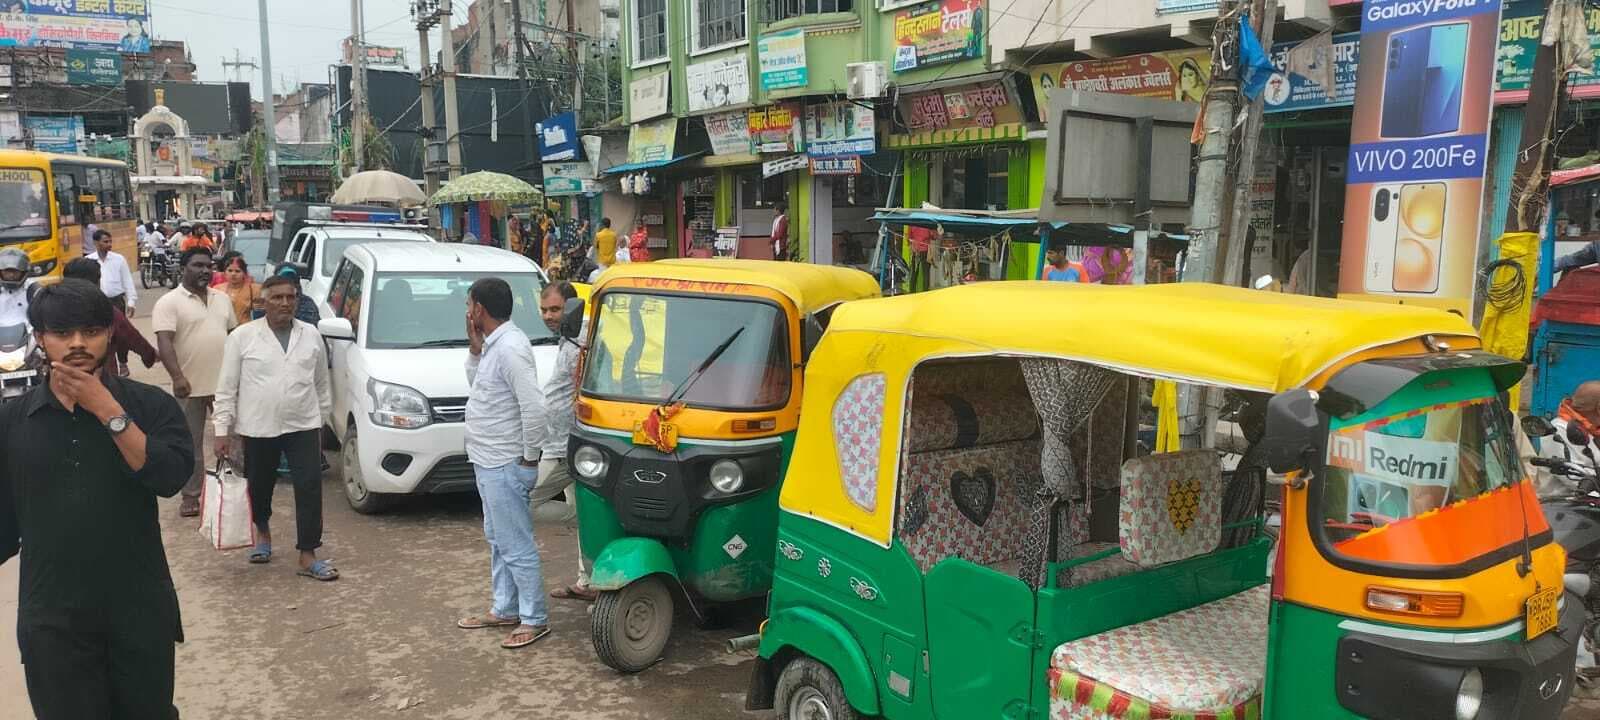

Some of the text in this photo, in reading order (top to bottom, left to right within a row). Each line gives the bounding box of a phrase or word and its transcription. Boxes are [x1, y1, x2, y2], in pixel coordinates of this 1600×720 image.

[113, 0, 145, 15] कयर
[1501, 15, 1543, 42] अष्ट
[1354, 144, 1477, 173] VIVO 200Fe
[0, 171, 32, 181] HOOL
[1370, 446, 1448, 480] Redmi
[727, 543, 744, 551] CNG
